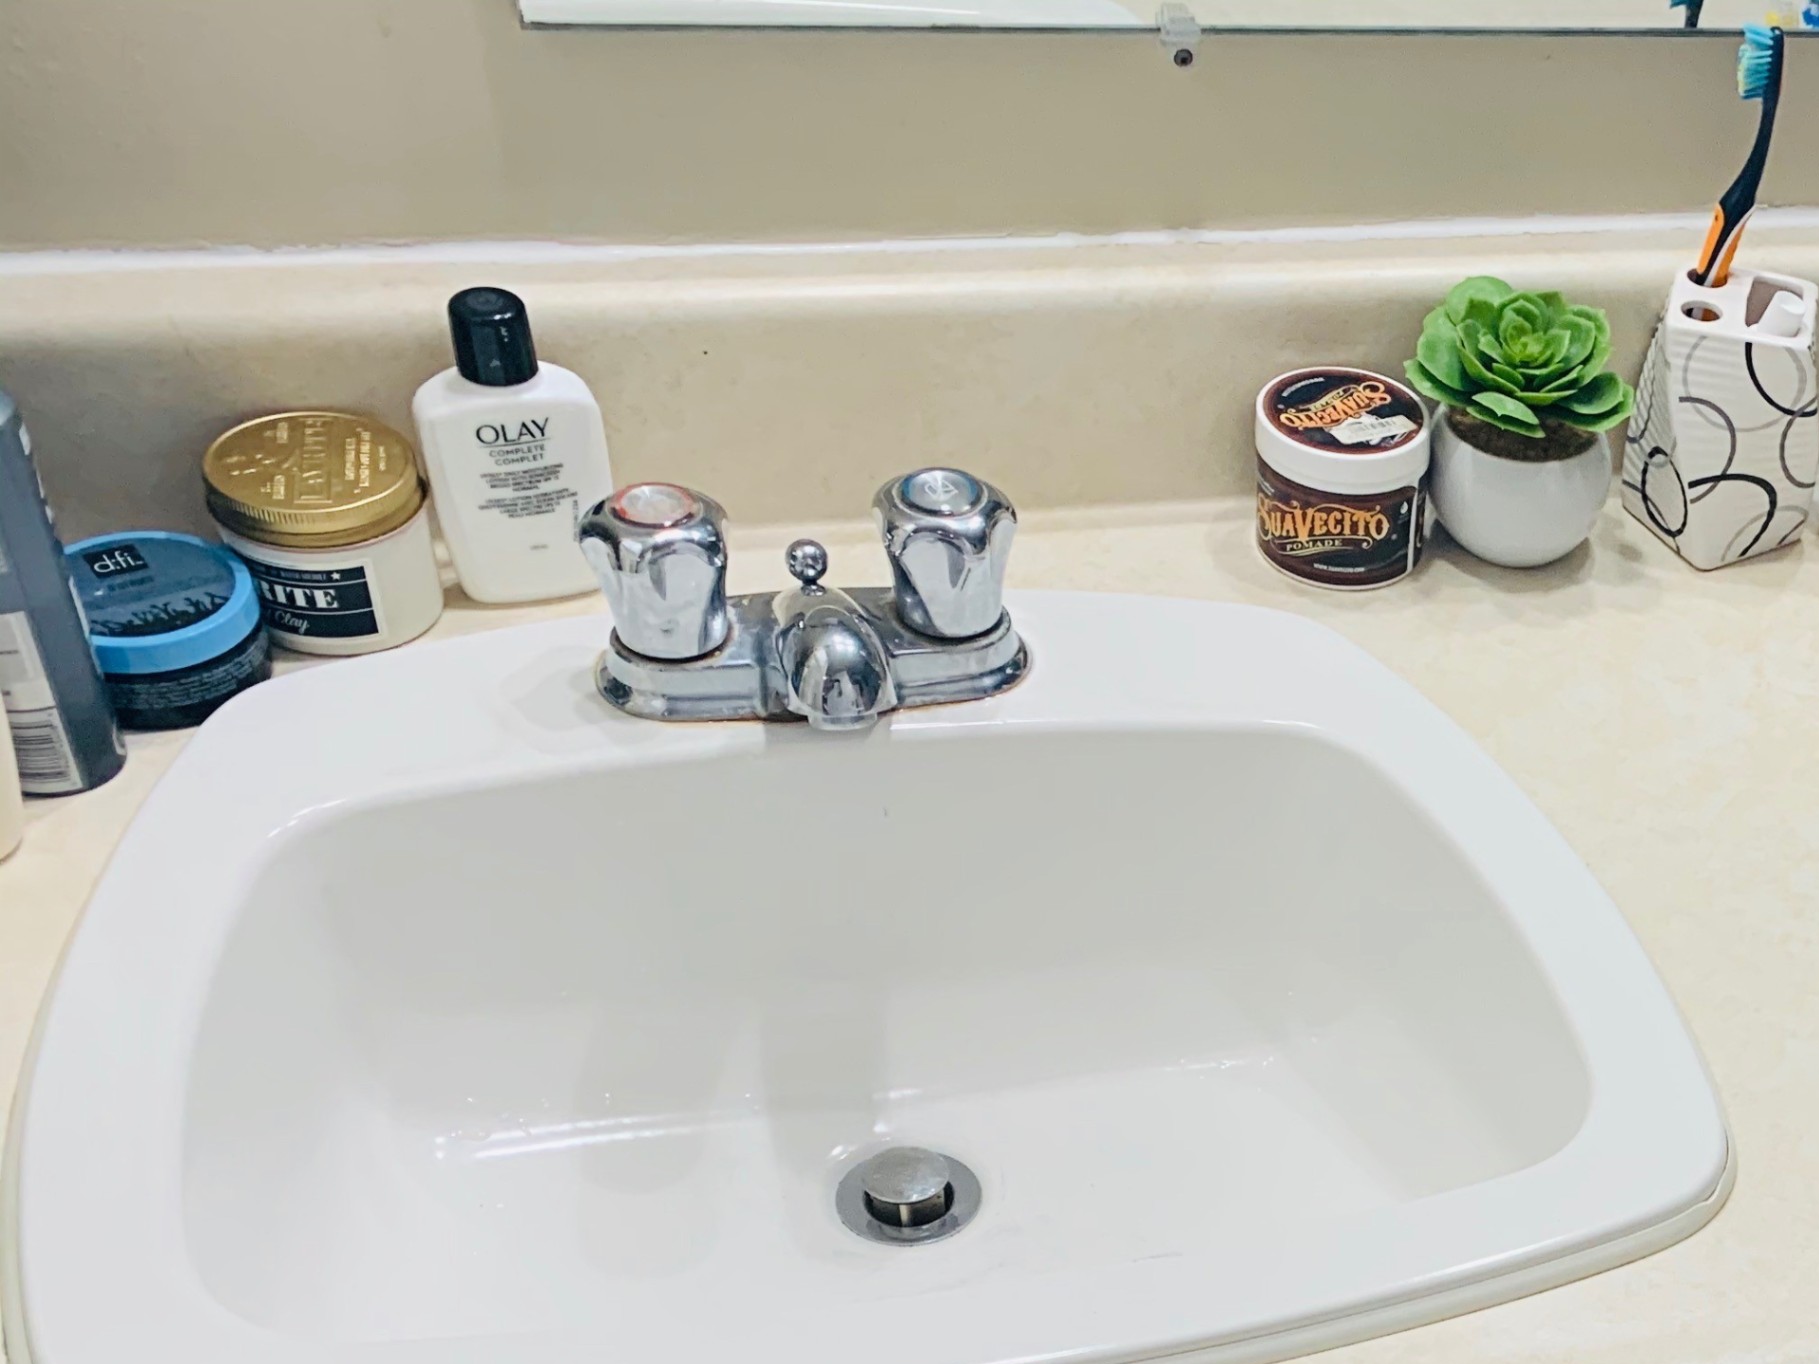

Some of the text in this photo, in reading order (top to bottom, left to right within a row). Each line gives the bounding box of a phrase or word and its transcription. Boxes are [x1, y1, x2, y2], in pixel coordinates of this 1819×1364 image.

[475, 417, 549, 445] OLAY
[488, 443, 546, 458] COMPLETE
[494, 452, 545, 466] COMPLET
[1286, 538, 1343, 551] POMADE
[274, 609, 311, 635] Clay
